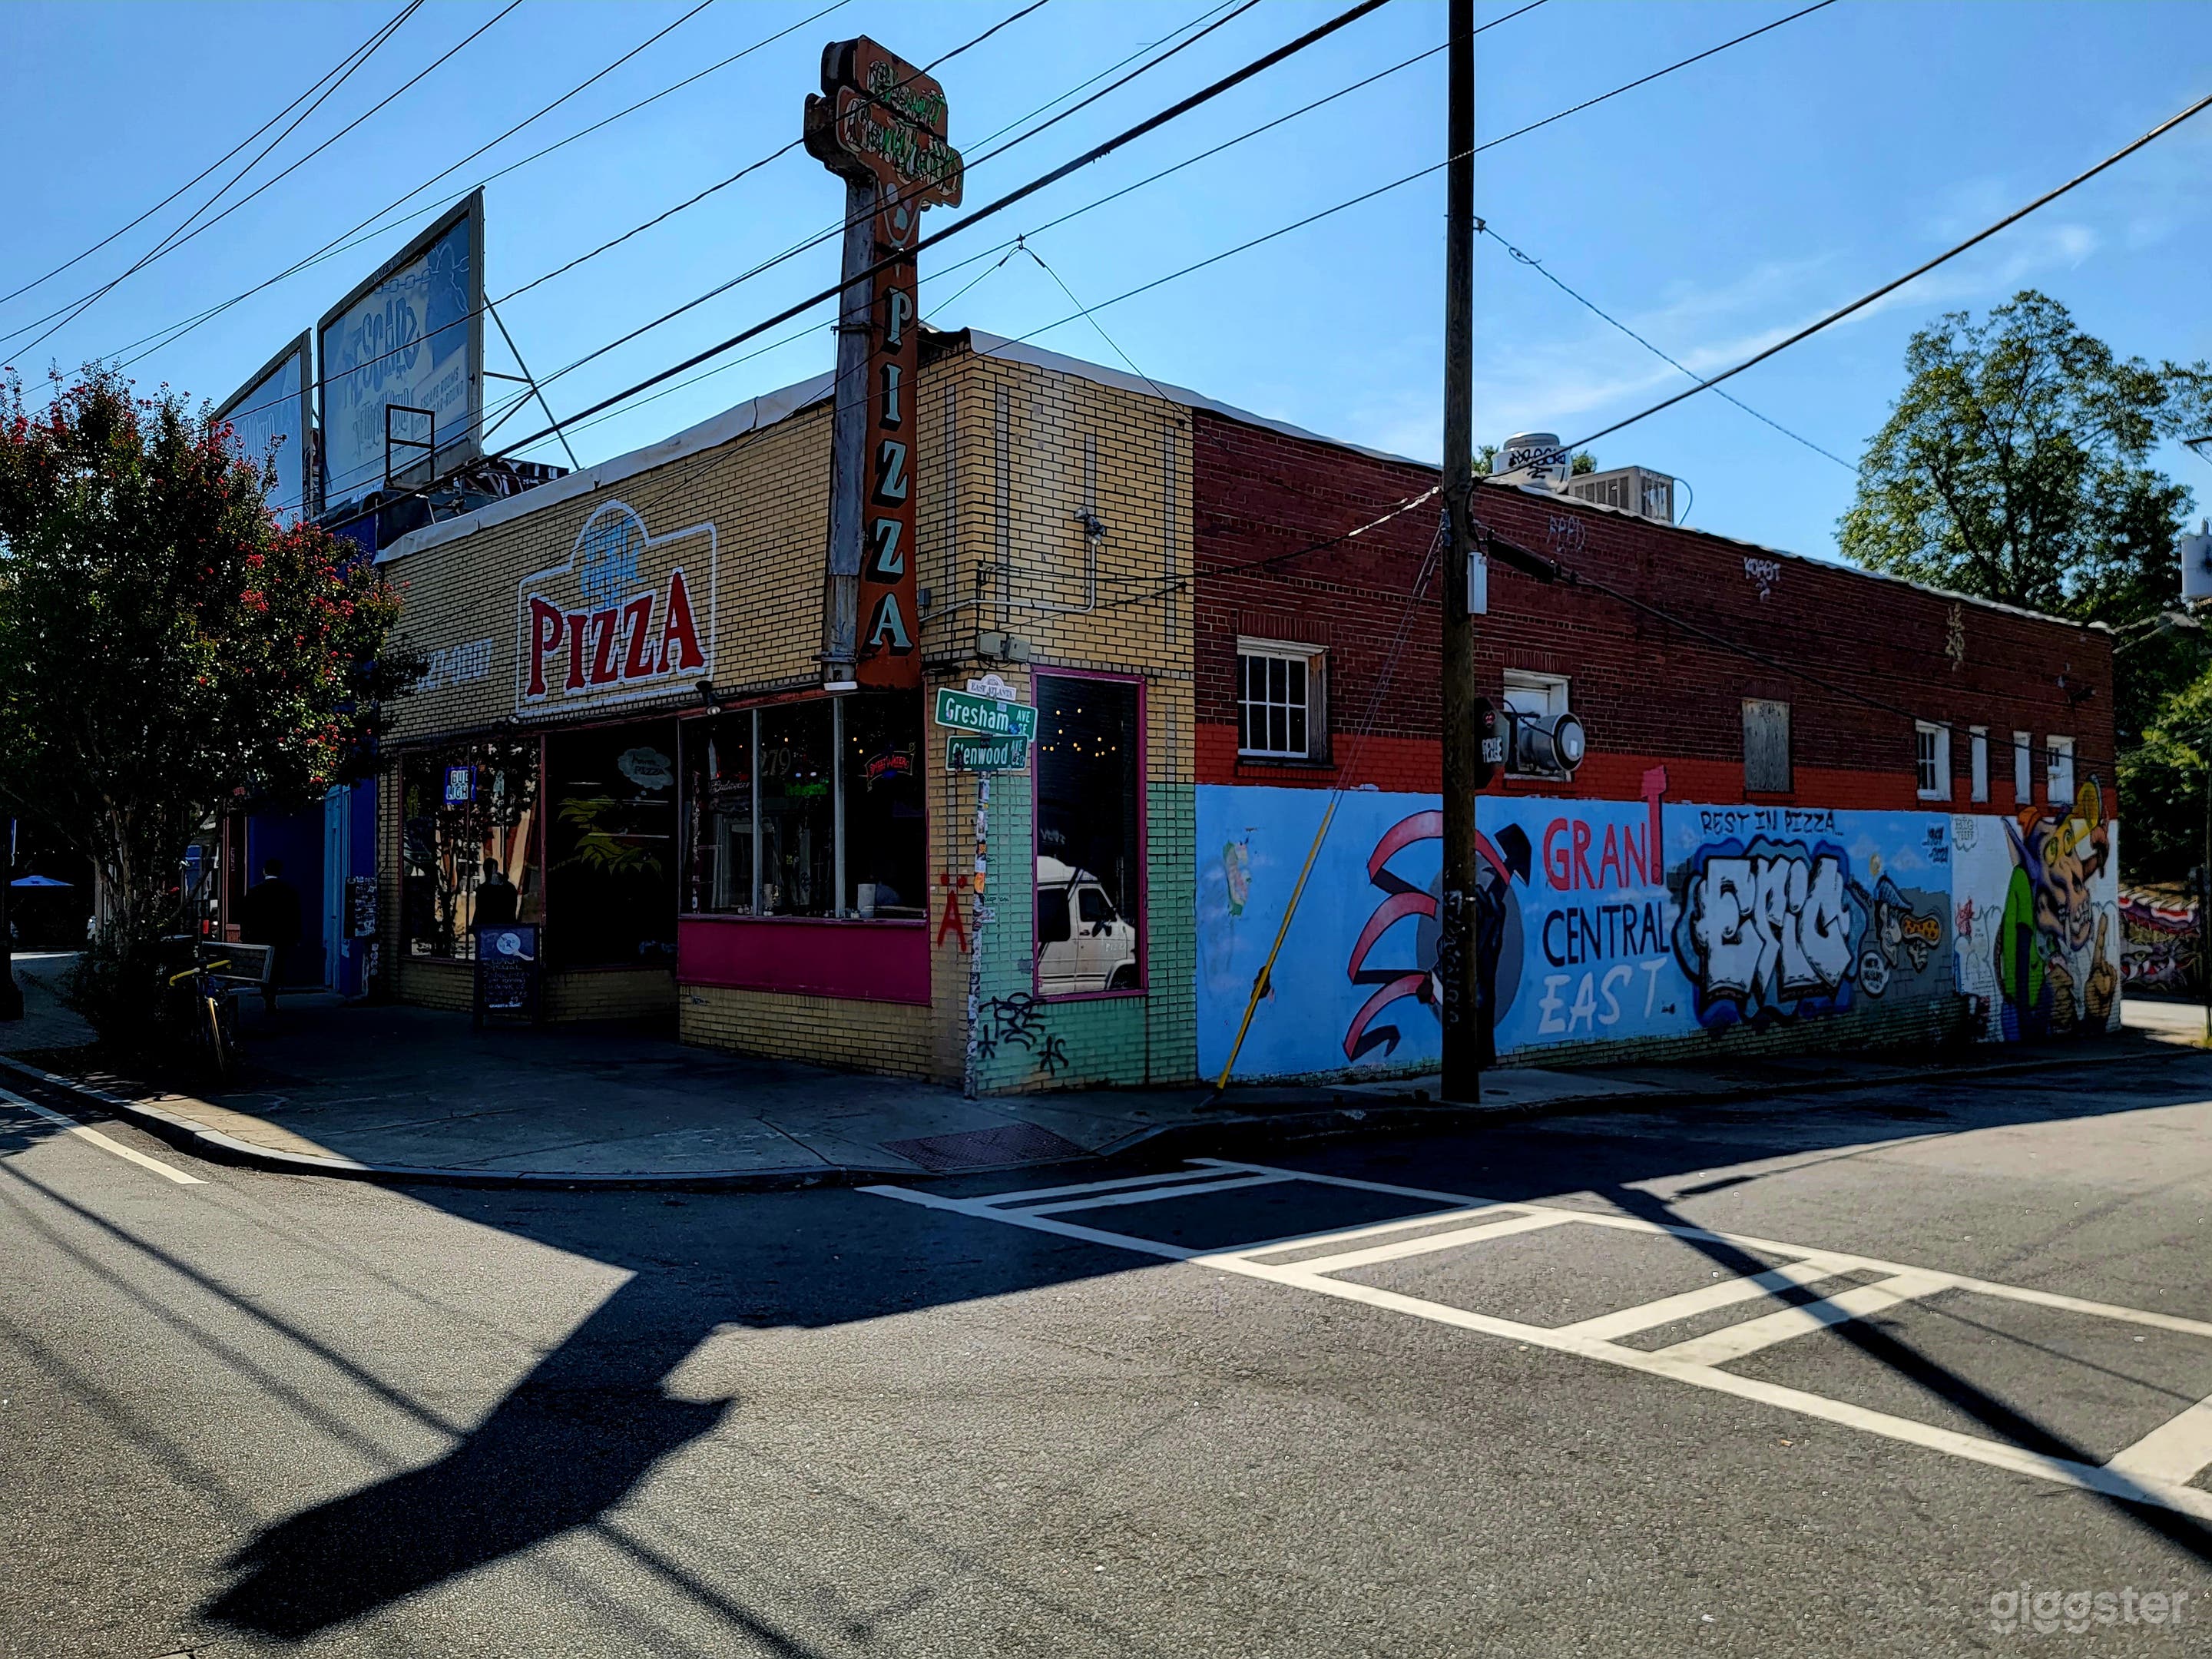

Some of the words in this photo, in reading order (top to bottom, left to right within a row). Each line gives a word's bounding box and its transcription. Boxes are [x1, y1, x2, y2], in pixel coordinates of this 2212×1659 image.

[869, 286, 914, 653] PIZZA
[526, 569, 706, 697] PIZZA
[945, 697, 1008, 732] Gresham
[1016, 710, 1031, 723] AVE
[971, 682, 987, 693] EAST
[988, 685, 1013, 698] ATLANTA
[1011, 740, 1024, 752] AVE
[446, 784, 475, 800] LIGH
[1543, 765, 1667, 891] GRANT
[1700, 810, 1750, 836] REST
[1753, 810, 1777, 831] IN
[1543, 901, 1670, 967] CENTRAL
[1538, 957, 1667, 1035] EAST
